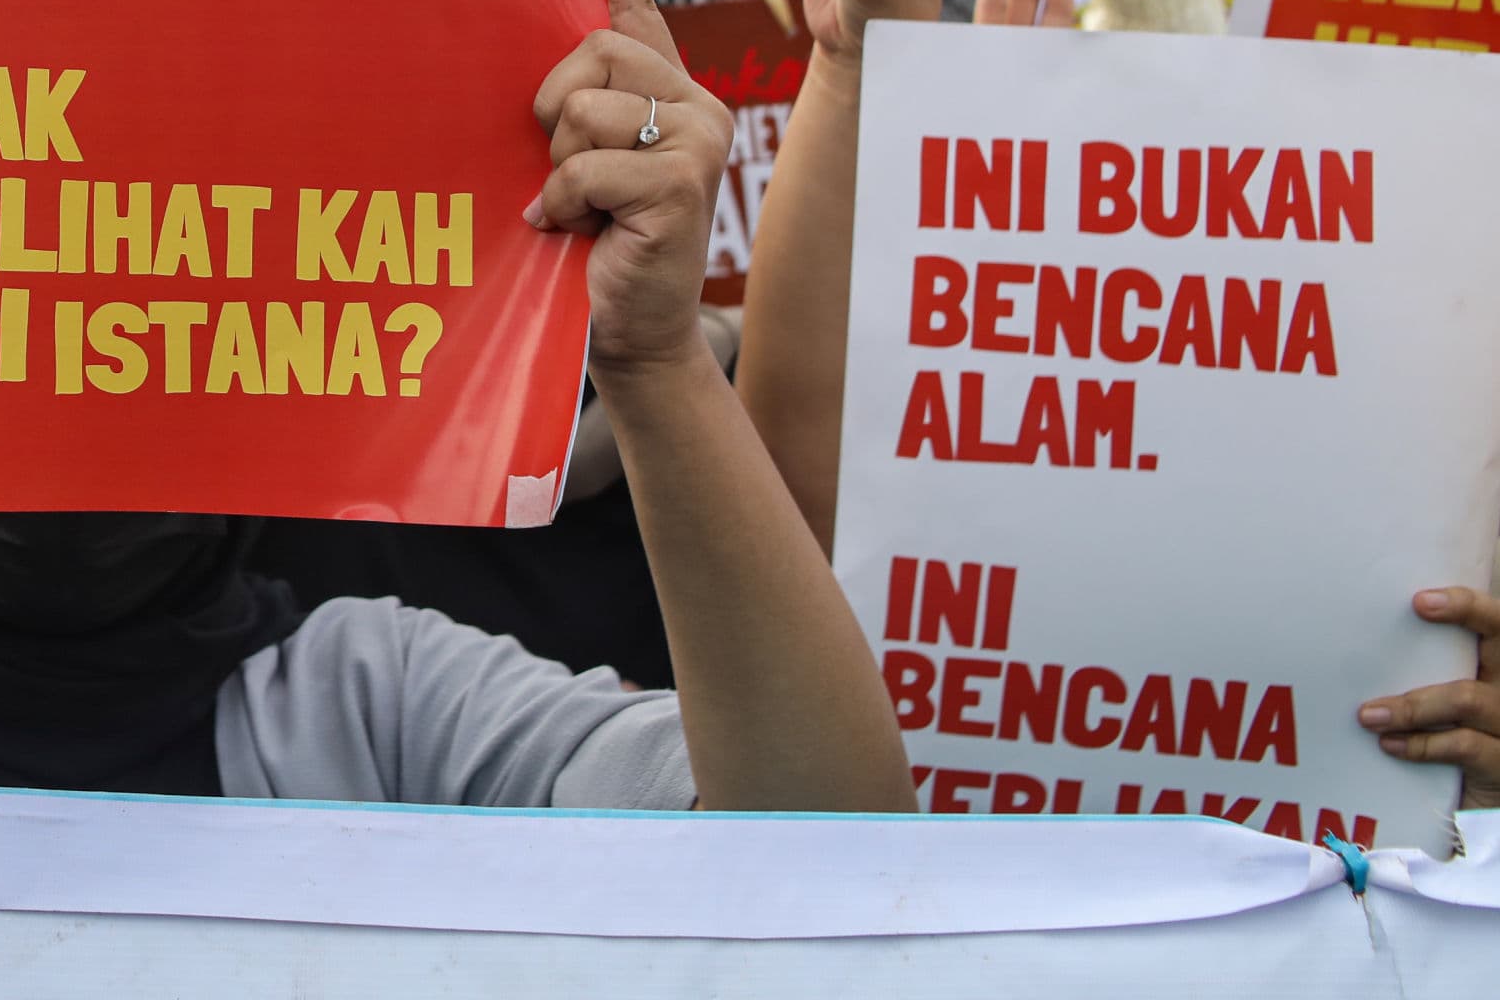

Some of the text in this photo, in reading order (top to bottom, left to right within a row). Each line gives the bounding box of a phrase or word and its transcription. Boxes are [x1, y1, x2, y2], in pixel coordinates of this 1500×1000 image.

[297, 188, 474, 287] KAH
[919, 138, 1372, 242] INI BUKAN
[54, 301, 444, 397] ISTANA?
[909, 255, 1338, 376] BENCANA
[894, 371, 1158, 471] ALAM.
[882, 556, 1017, 650] INI
[882, 650, 1297, 766] BENCANA
